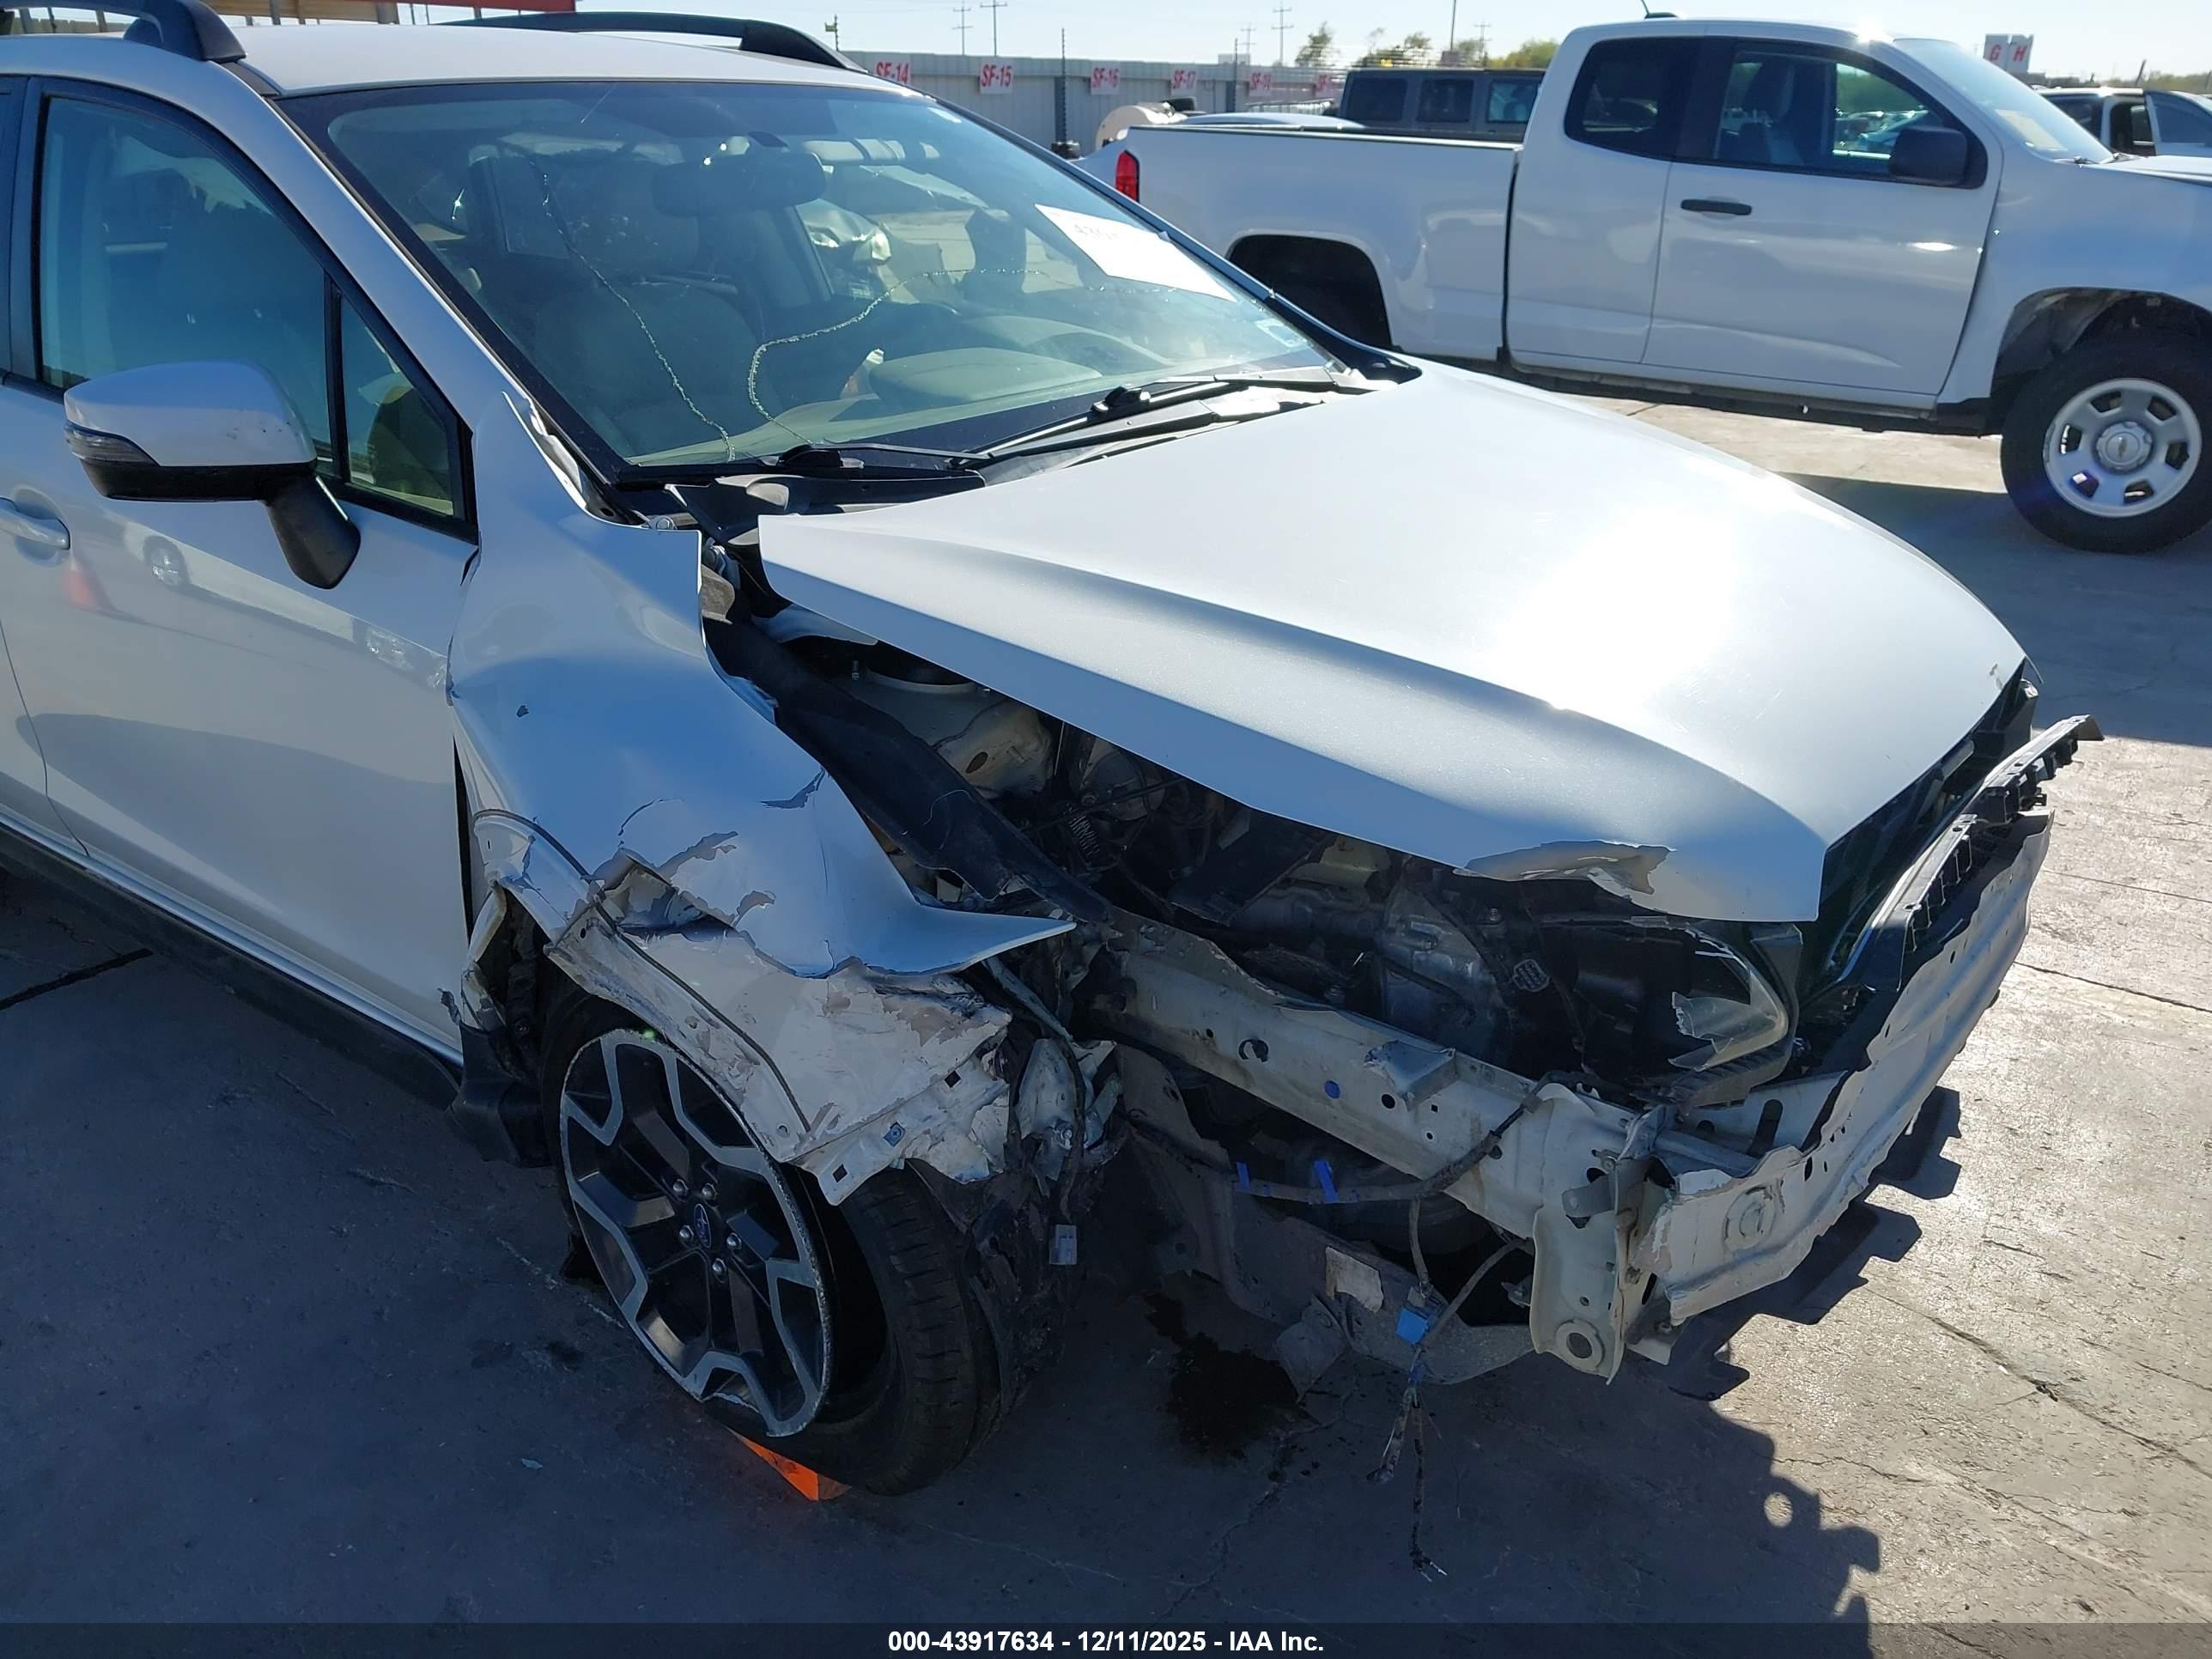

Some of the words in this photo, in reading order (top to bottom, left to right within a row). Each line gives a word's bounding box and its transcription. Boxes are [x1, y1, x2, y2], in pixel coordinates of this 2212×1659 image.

[1989, 44, 2002, 61] G
[2013, 45, 2027, 62] H
[875, 61, 909, 84] SF-14
[981, 64, 1012, 87] SF-15
